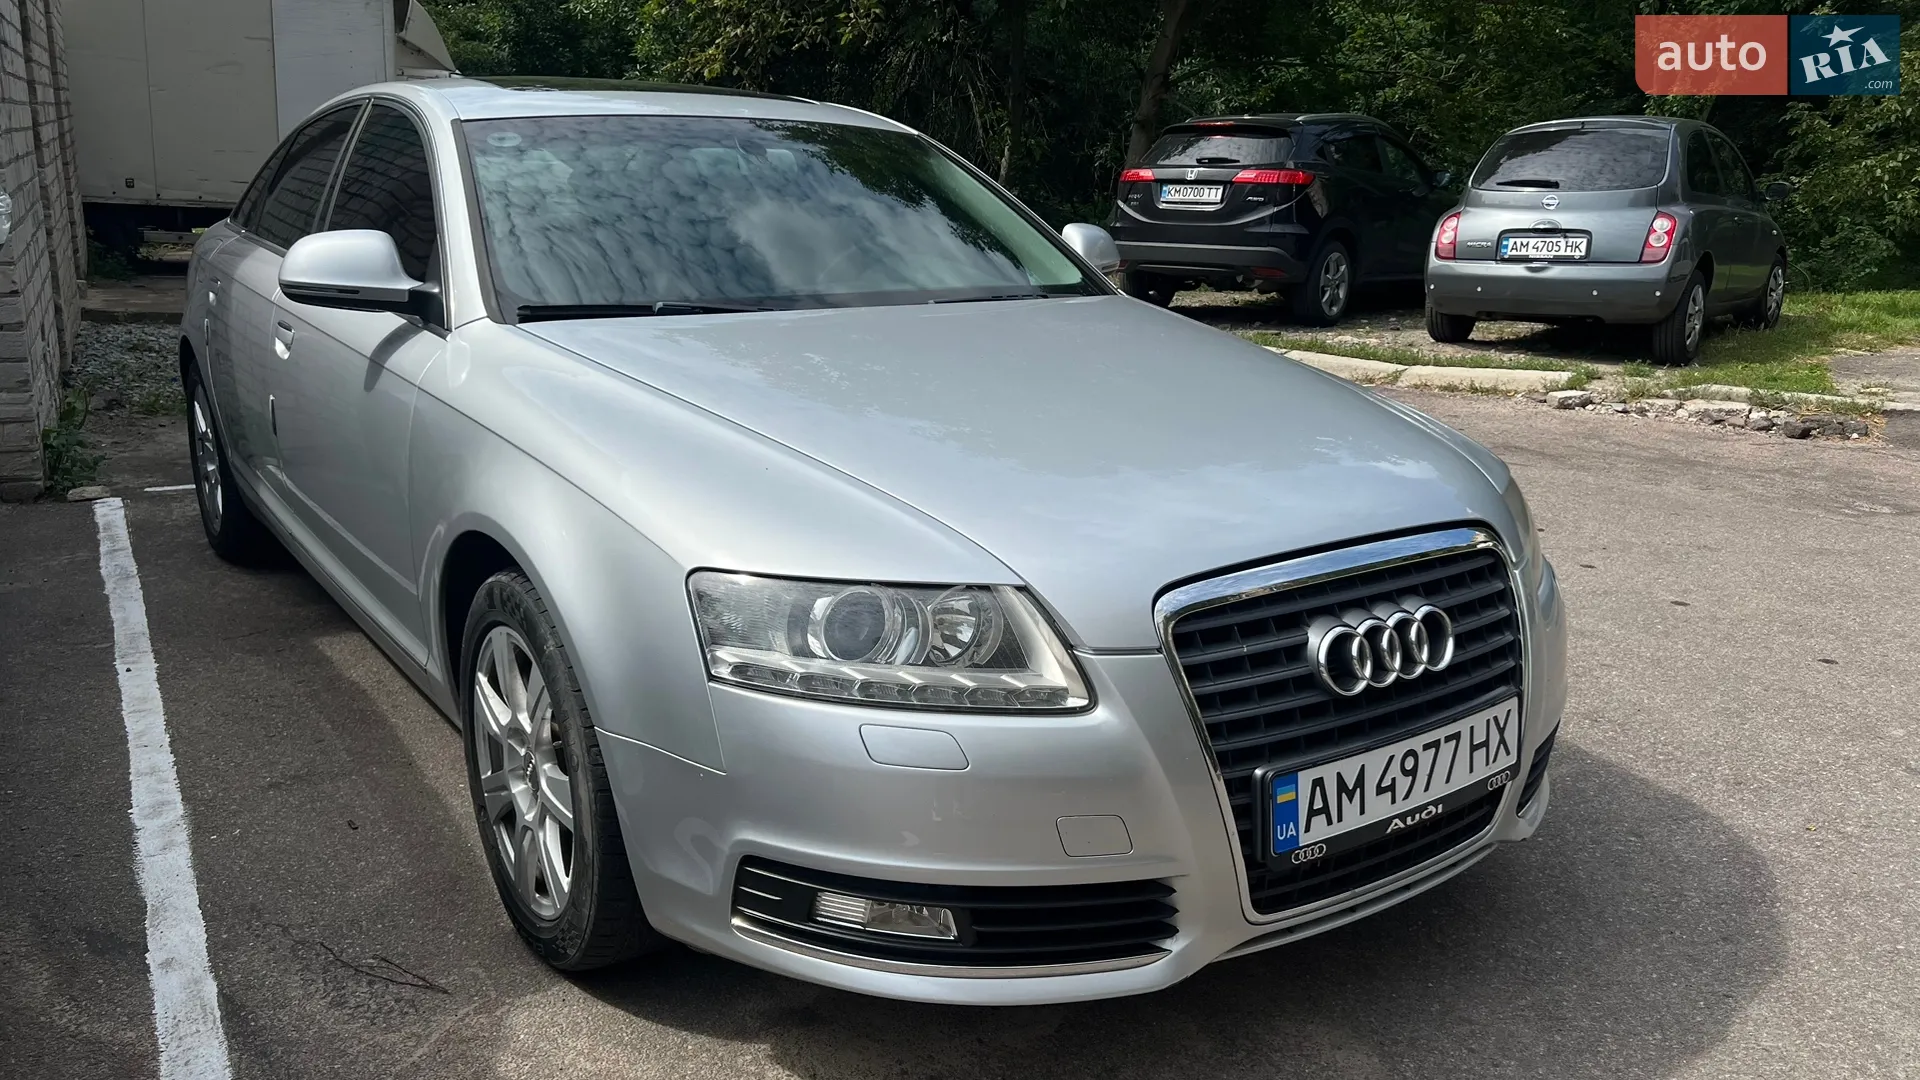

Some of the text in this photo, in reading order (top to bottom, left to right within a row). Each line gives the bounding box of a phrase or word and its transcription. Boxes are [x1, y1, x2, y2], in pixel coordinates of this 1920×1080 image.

[1166, 187, 1221, 198] KM 0700 TT
[1509, 240, 1583, 254] AM 4705 HK
[1303, 707, 1512, 834] AM 4977 HX
[1385, 803, 1443, 834] Audi
[1276, 821, 1297, 840] UA
